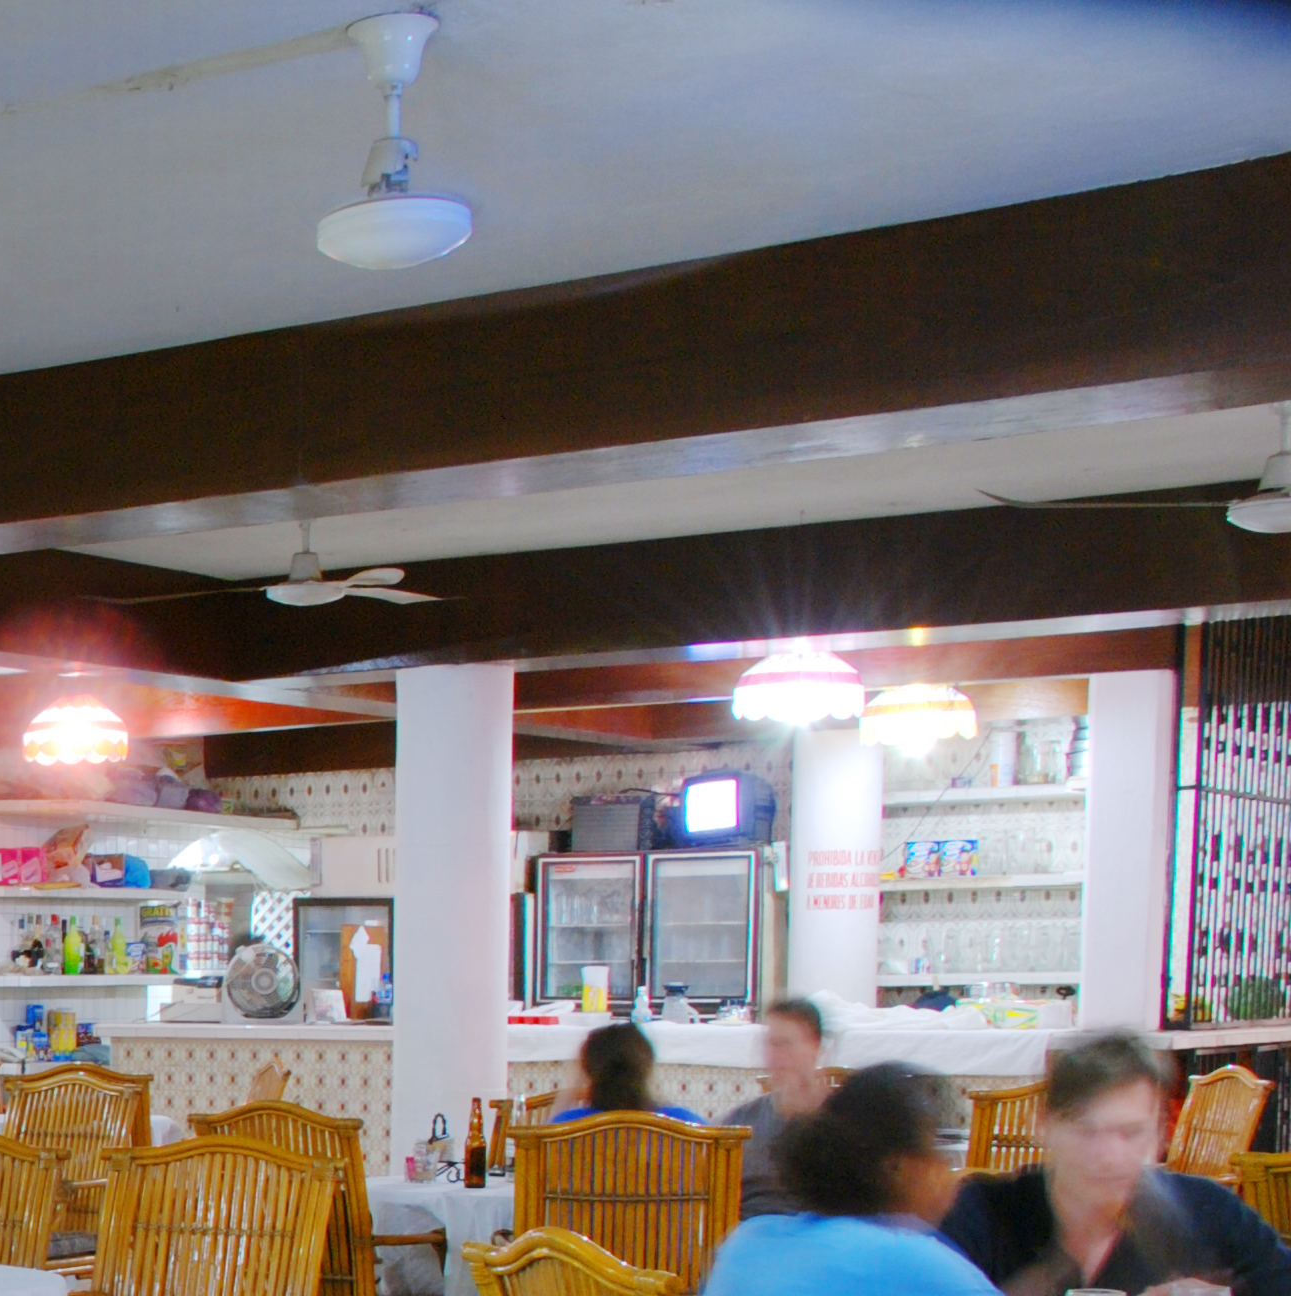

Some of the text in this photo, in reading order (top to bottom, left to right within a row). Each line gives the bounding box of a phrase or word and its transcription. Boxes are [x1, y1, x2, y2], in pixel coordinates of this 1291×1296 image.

[808, 850, 851, 867] PROHIBIDA
[855, 850, 864, 867] LA
[816, 872, 848, 888] BEBIDAS
[813, 894, 845, 910] MENORES
[848, 894, 857, 910] DE
[860, 894, 874, 910] EDAD
